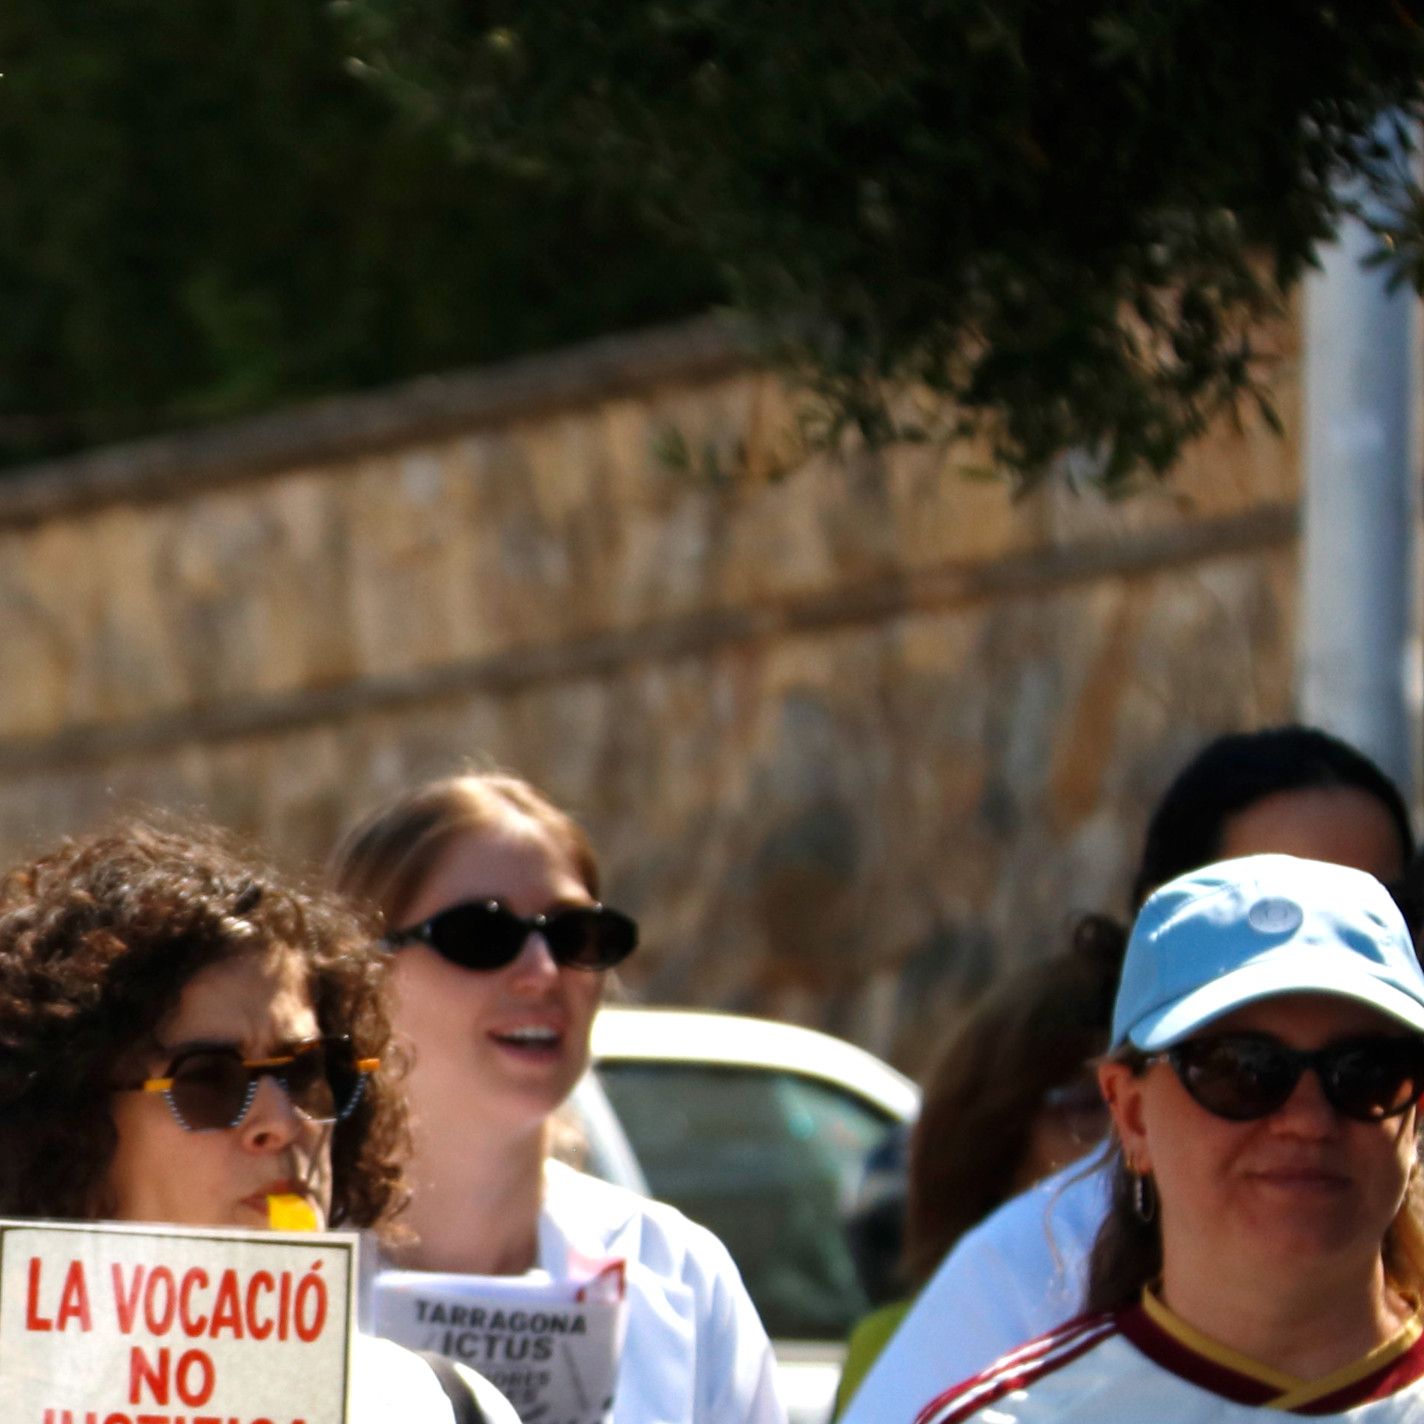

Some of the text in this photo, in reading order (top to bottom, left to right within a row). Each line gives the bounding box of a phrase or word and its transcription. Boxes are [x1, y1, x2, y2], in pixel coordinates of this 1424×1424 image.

[24, 1256, 328, 1342] LA VOCACIÓ
[415, 1299, 587, 1336] TARRAGONA
[442, 1329, 555, 1362] ICTUS
[129, 1346, 216, 1407] NO
